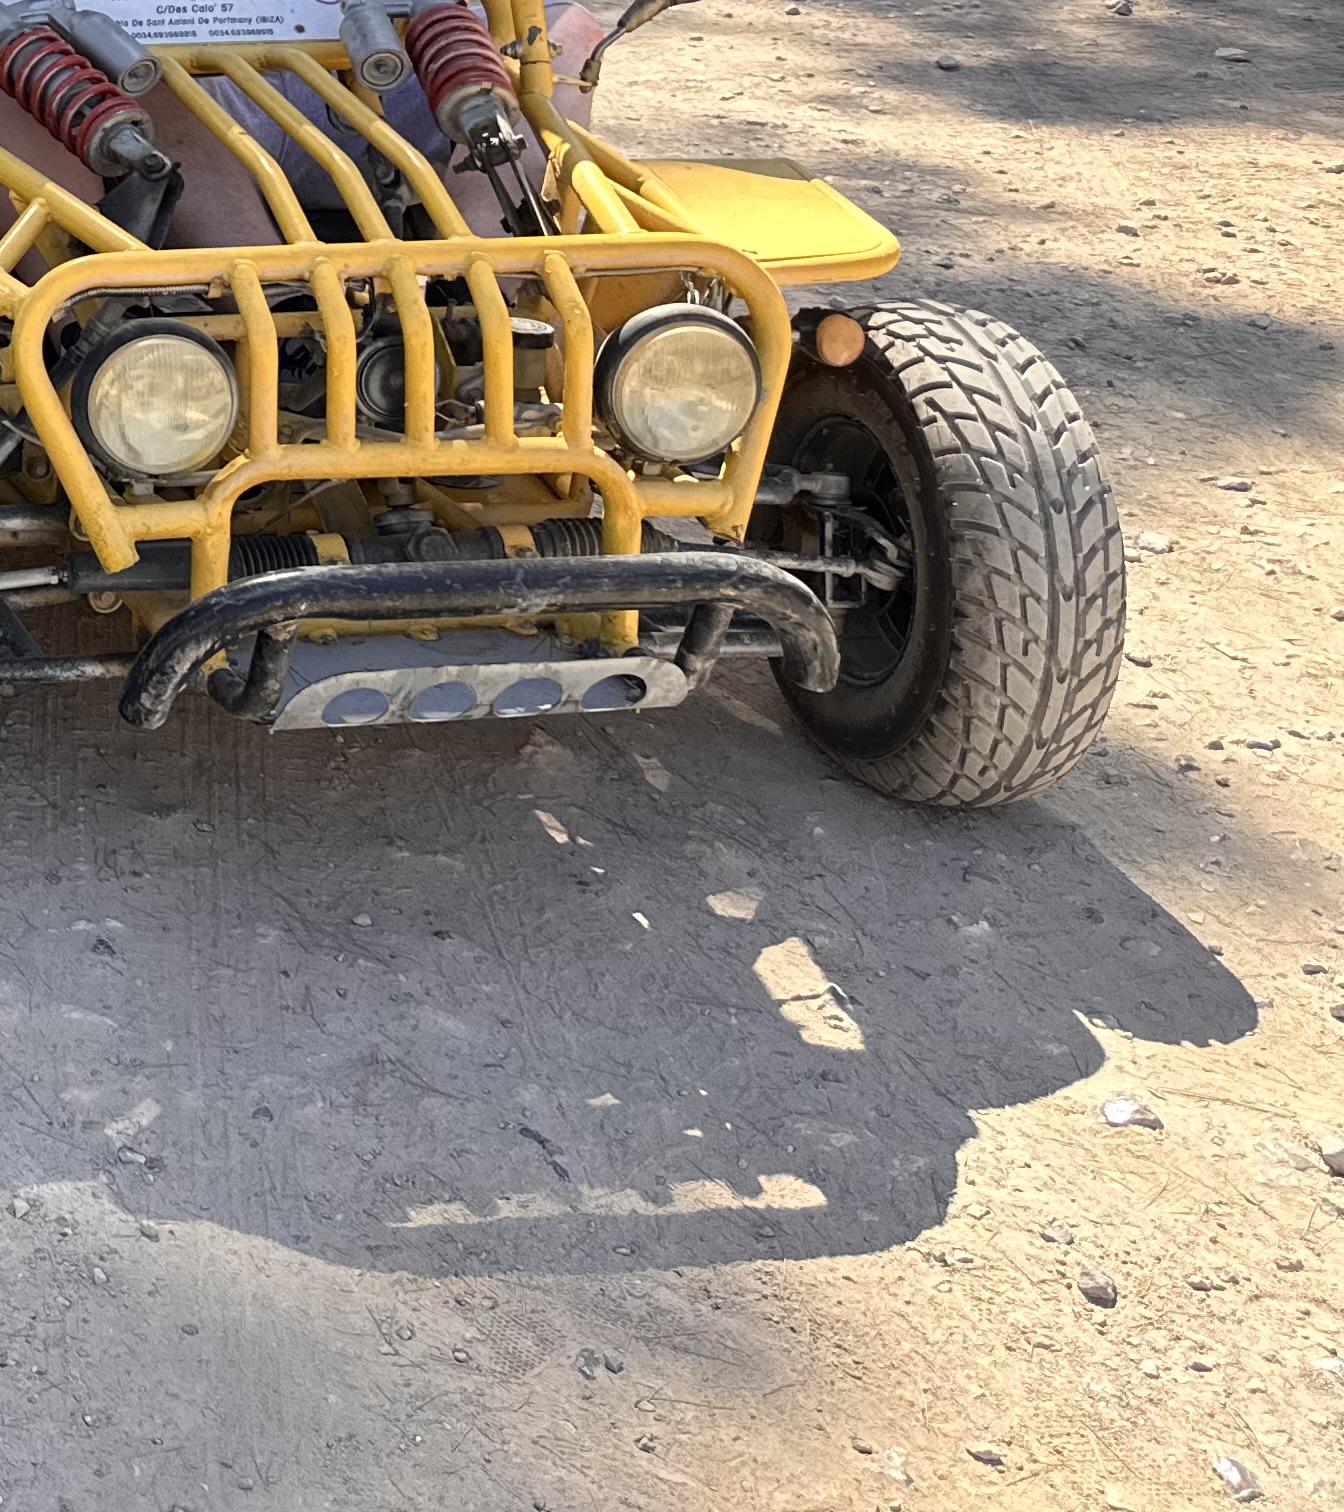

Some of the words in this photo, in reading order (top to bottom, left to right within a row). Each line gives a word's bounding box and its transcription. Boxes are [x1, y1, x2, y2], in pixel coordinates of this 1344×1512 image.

[156, 5, 188, 15] C/Des
[221, 3, 234, 13] 57
[131, 19, 143, 27] De
[198, 16, 210, 25] De
